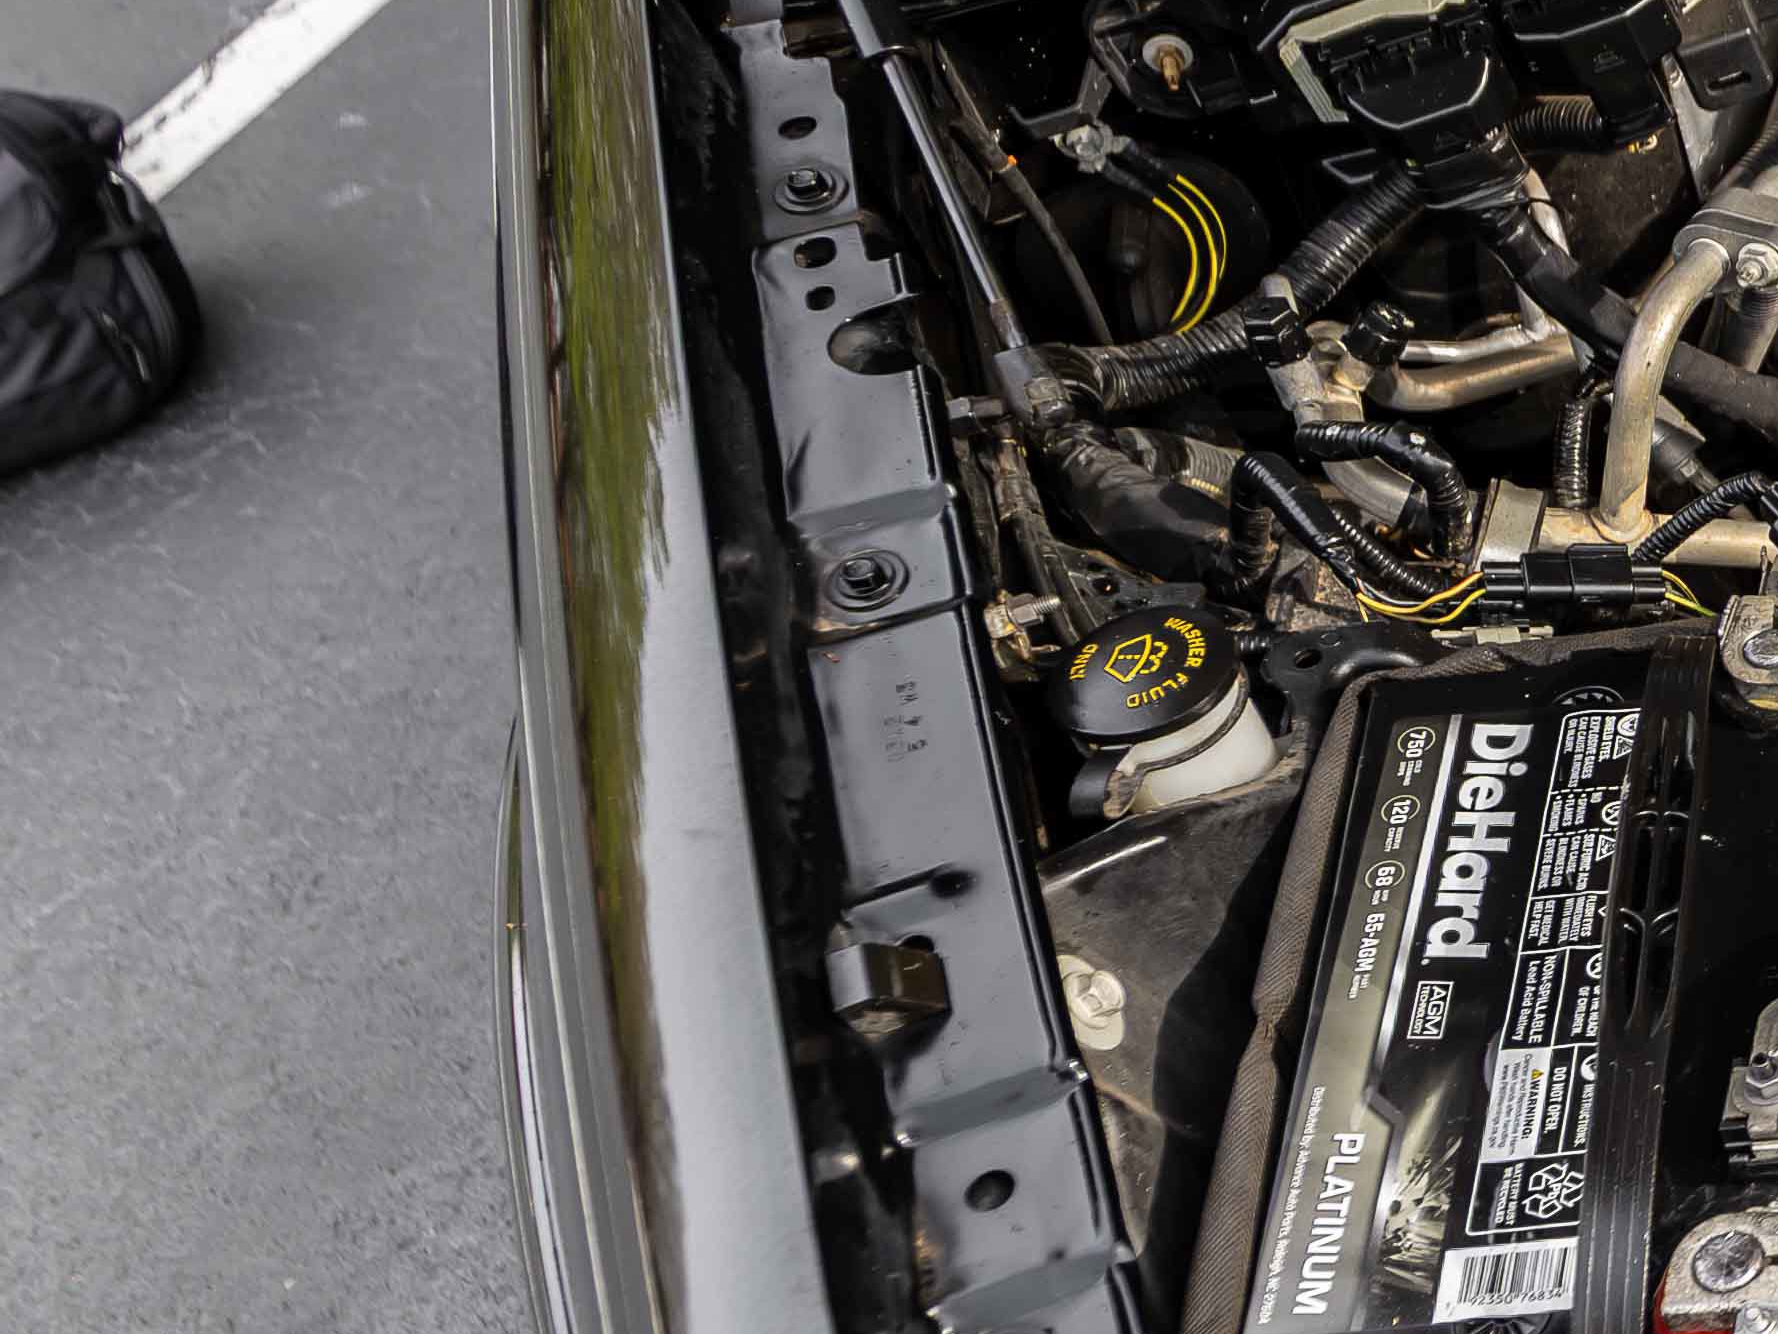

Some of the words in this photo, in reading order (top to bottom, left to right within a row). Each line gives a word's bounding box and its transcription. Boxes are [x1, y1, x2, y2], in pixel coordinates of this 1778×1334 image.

[1162, 617, 1207, 668] WASHER
[1068, 643, 1099, 681] ONLY
[1125, 671, 1190, 709] FLUID
[1578, 716, 1588, 729] CAN
[1585, 716, 1600, 754] EXPLOSIVE
[1602, 715, 1615, 739] SHIELD
[1403, 728, 1427, 759] 750
[1574, 730, 1585, 753] CAUSE
[1598, 741, 1611, 761] EYES.
[1581, 756, 1594, 778] GASES
[1388, 798, 1411, 826] 120
[1542, 838, 1555, 863] SEVERE
[1570, 836, 1580, 849] CAN
[1578, 833, 1594, 870] SULFURIC
[1552, 838, 1568, 875] BLINDNESS
[1374, 864, 1395, 889] 68
[1575, 872, 1588, 890] ACID
[1532, 901, 1543, 918] HELP
[1544, 900, 1554, 914] GET
[1562, 898, 1573, 915] WITH
[1584, 895, 1596, 917] FLUSH
[1537, 914, 1552, 945] MEDICAL
[1581, 918, 1593, 936] EYES
[1353, 911, 1385, 974] 65-AGM
[1526, 960, 1539, 983] Lead
[1521, 986, 1535, 1005] Acid
[1528, 955, 1556, 1043] NON-SPILLABLE
[1578, 986, 1589, 996] OF
[1421, 984, 1448, 1035] AGM
[1422, 985, 1432, 1036] TECHNOLOGY
[1511, 1008, 1531, 1040] Battery
[1551, 1067, 1567, 1080] DO
[1549, 1083, 1564, 1101] NOT
[1302, 1085, 1325, 1135] Distributed
[1521, 1080, 1540, 1138] WARNING:
[1543, 1105, 1560, 1133] OPEN.
[1289, 1149, 1310, 1188] Advance
[1508, 1163, 1523, 1199] BATTERY
[1284, 1187, 1299, 1210] Auto
[1494, 1181, 1509, 1223] RECYCLED
[1290, 1132, 1366, 1315] PLATINUM
[1265, 1276, 1279, 1293] NC
